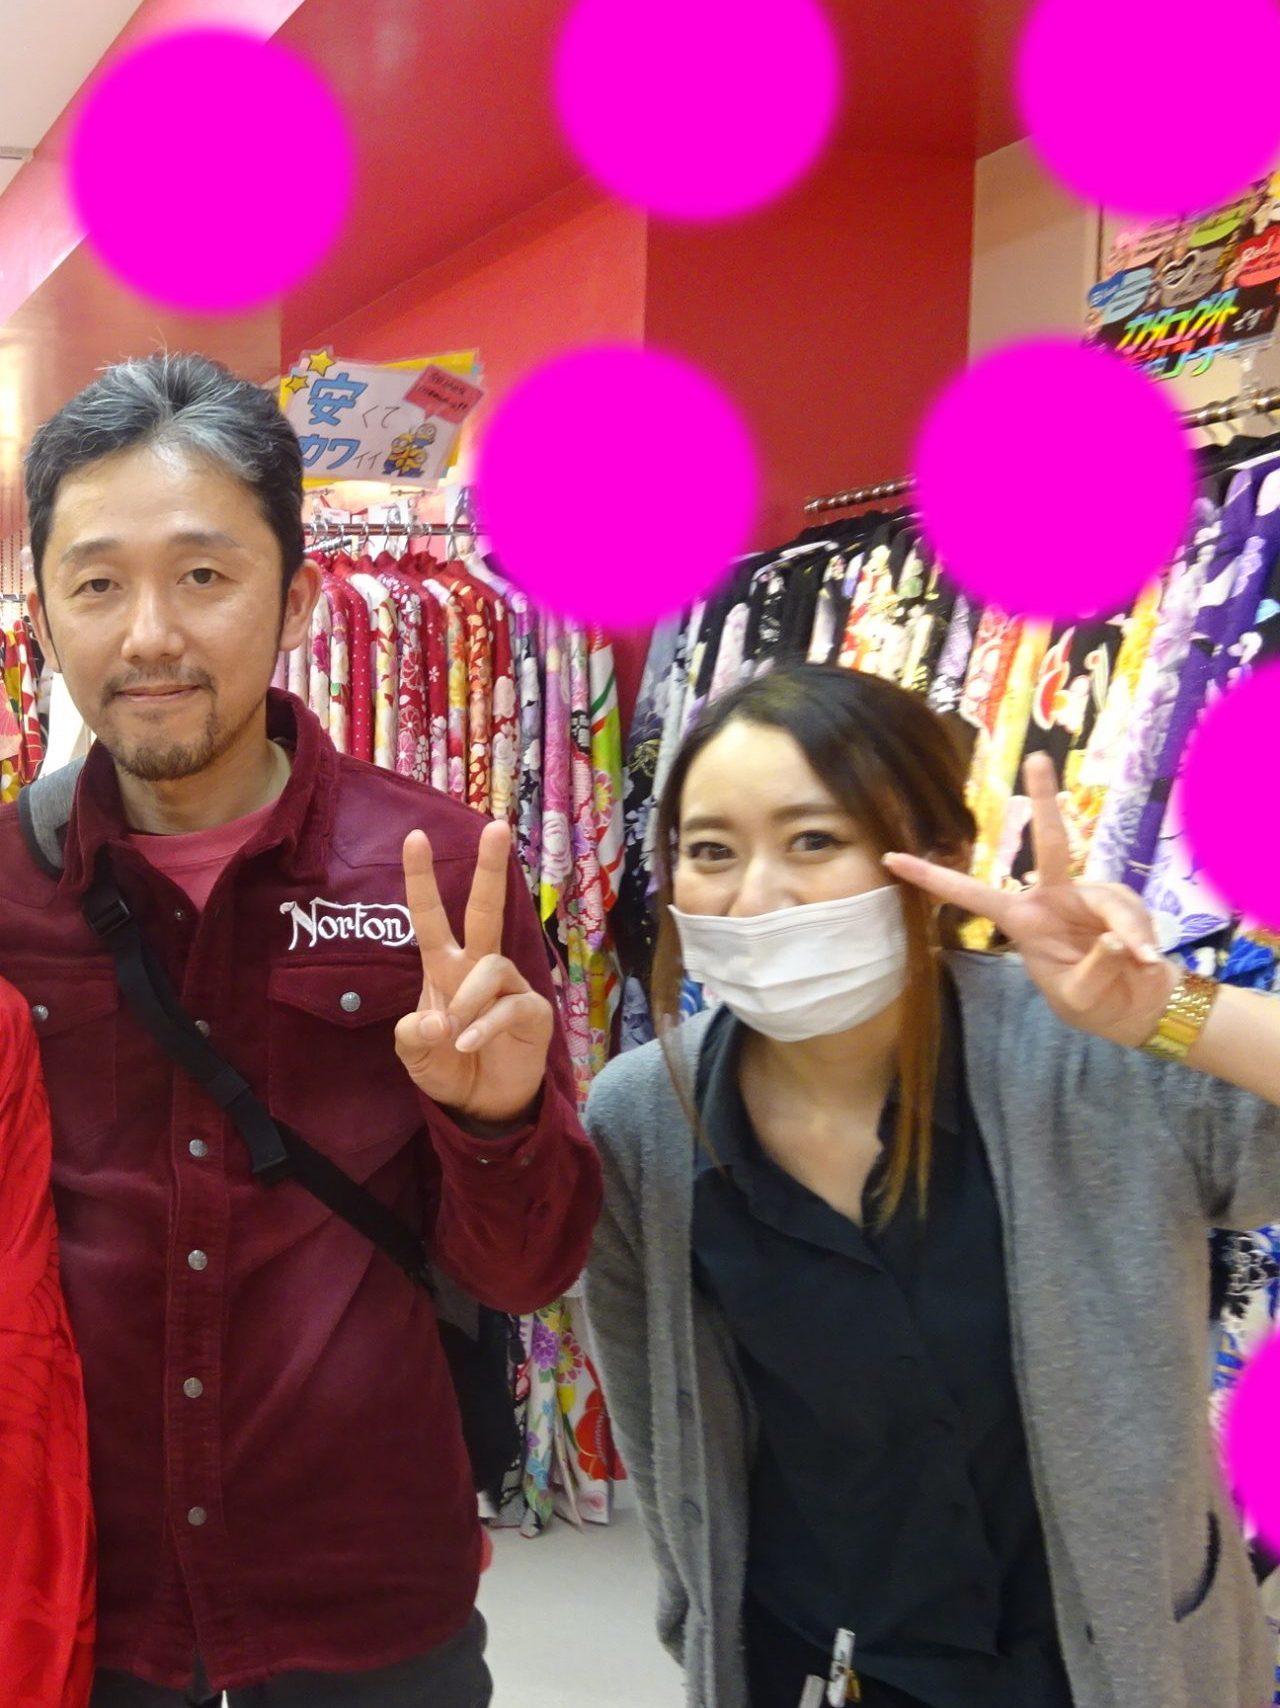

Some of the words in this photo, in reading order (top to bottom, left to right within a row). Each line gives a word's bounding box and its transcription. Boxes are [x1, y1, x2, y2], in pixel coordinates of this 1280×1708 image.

[307, 372, 401, 429] 安くて
[298, 433, 383, 470] カワイイ
[279, 896, 417, 951] Norton
